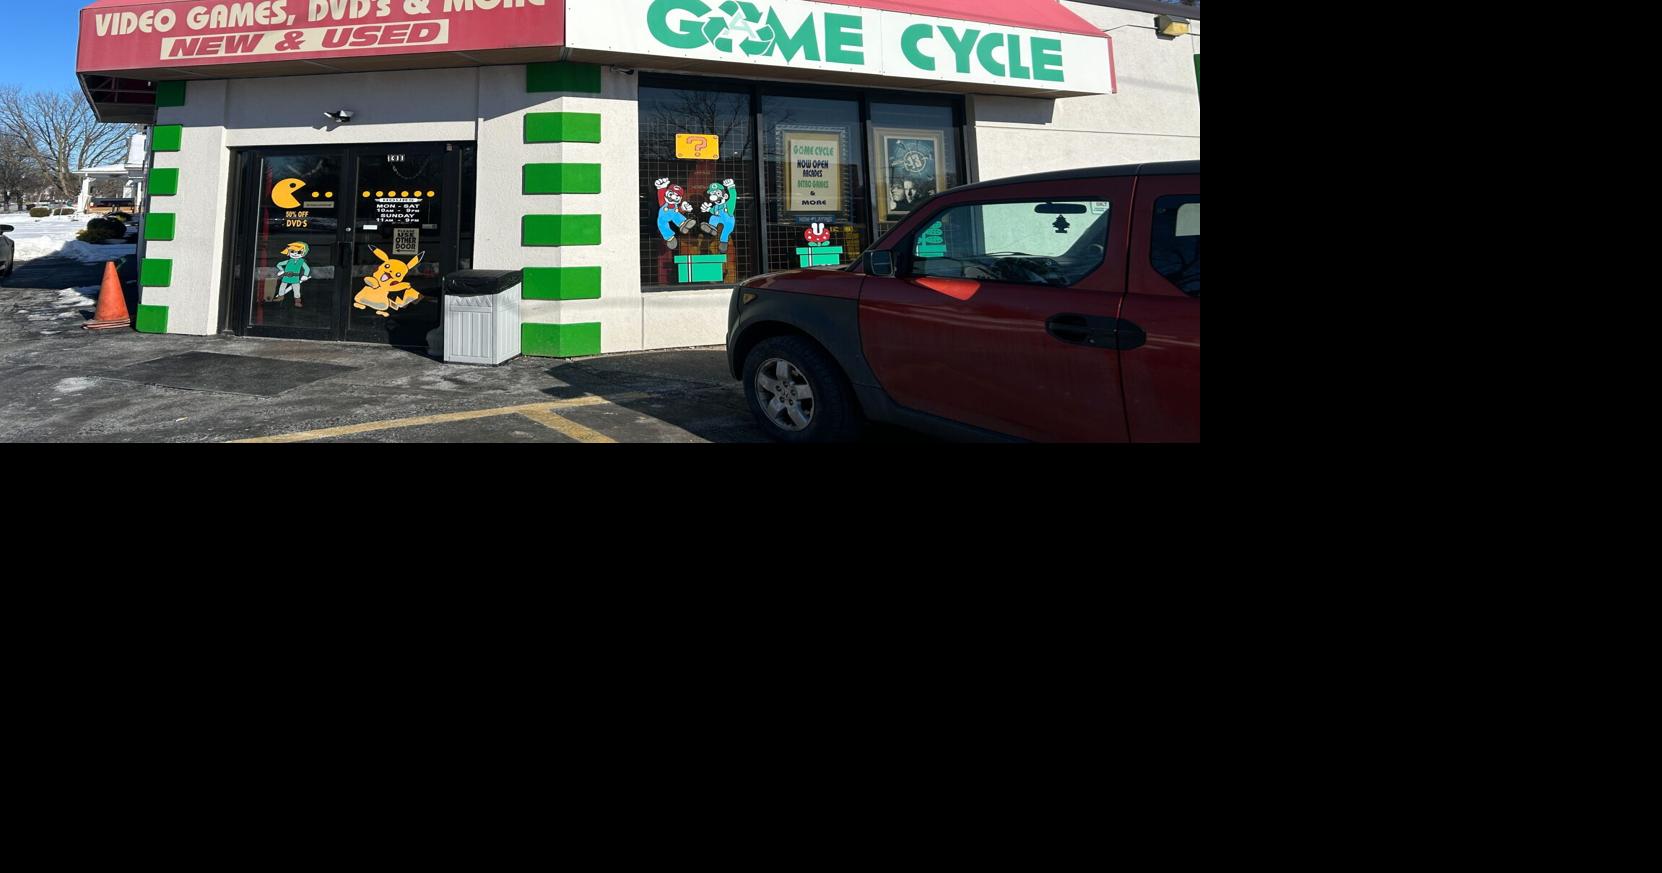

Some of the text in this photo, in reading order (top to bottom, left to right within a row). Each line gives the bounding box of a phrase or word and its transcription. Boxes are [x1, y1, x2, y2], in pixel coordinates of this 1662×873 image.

[95, 9, 176, 37] VIDEO
[187, 0, 296, 30] GAMES,
[308, 0, 391, 20] DVDs
[168, 22, 441, 57] NEW & USED
[647, 0, 1065, 82] GAME CYCLE
[797, 160, 829, 168] NOW OPEN
[815, 146, 834, 156] CYCLE
